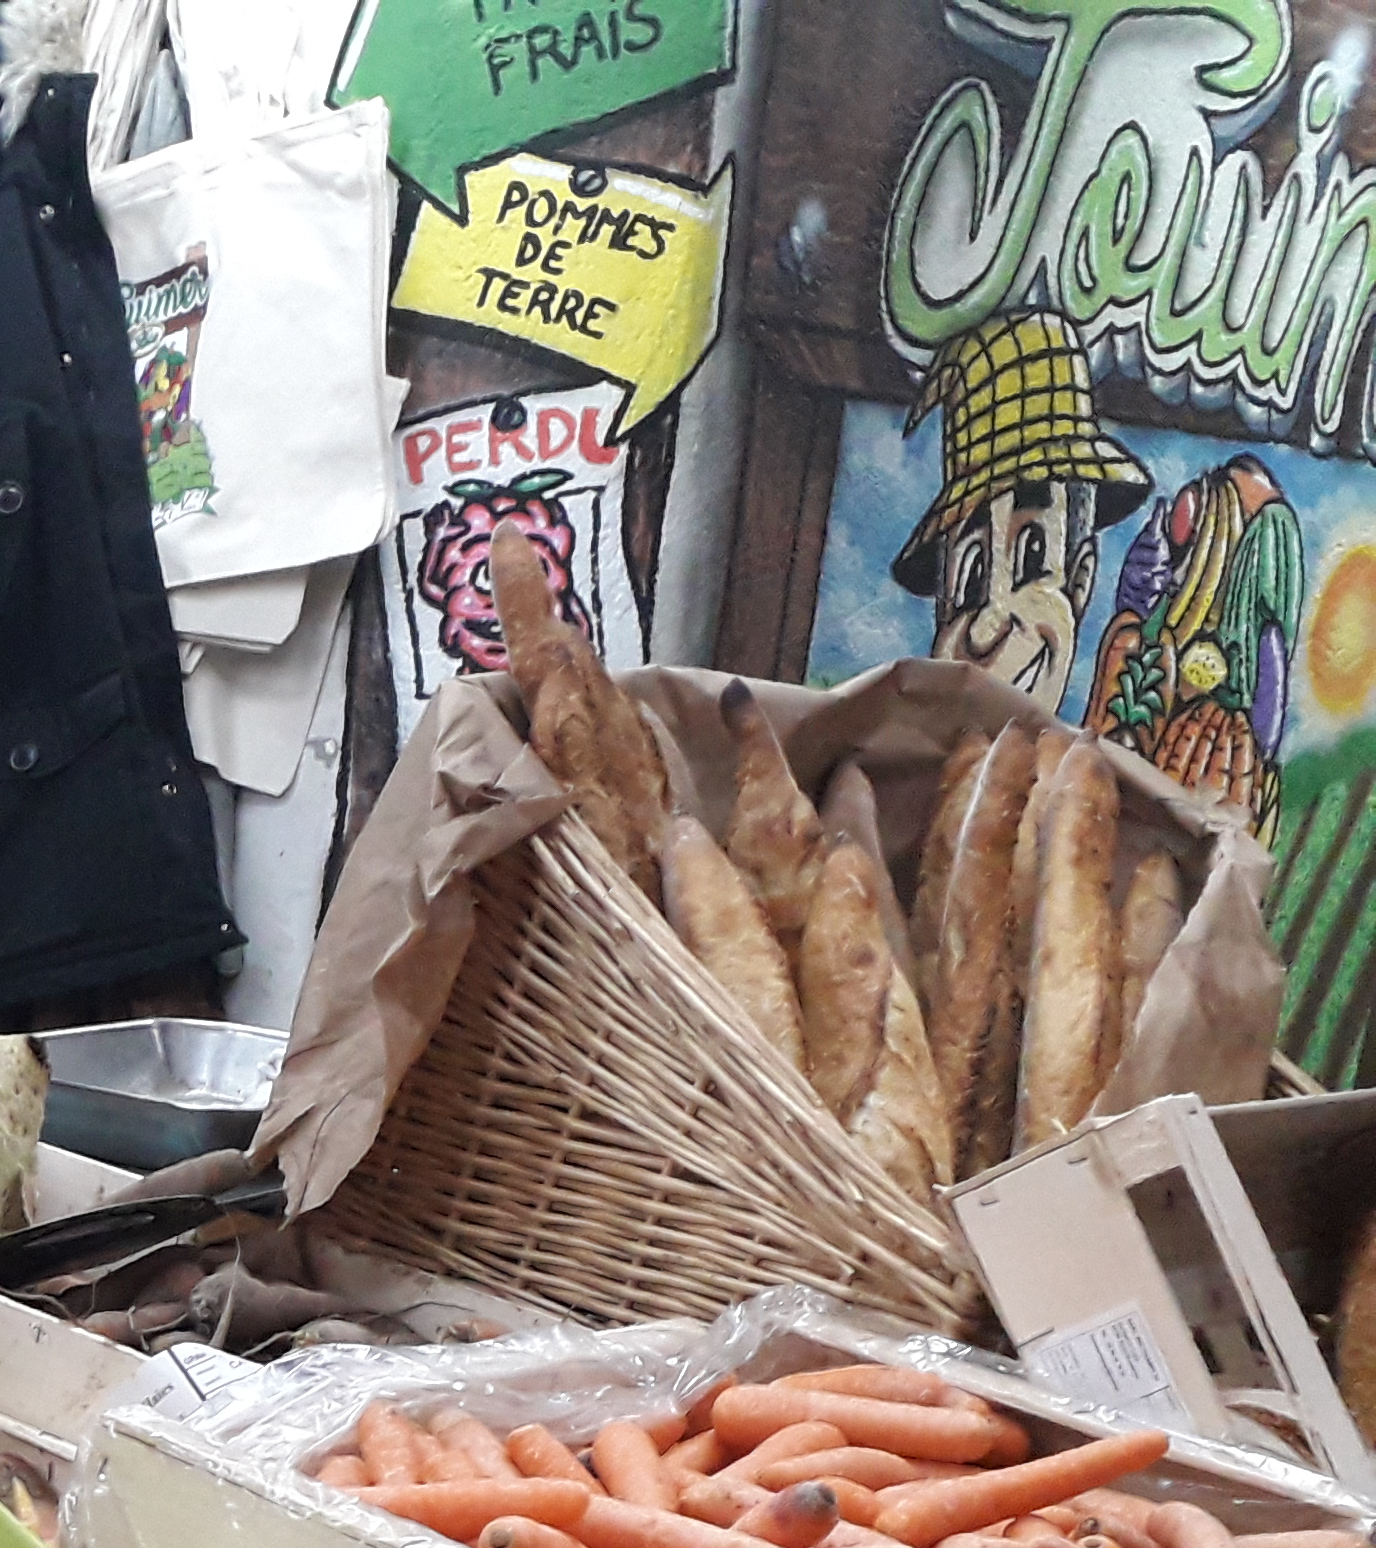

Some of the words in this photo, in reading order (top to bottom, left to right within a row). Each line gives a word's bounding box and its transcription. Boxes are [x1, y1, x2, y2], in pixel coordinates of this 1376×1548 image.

[483, 0, 665, 96] FRAIS
[495, 180, 677, 260] POMMES
[514, 230, 573, 275] DE
[474, 266, 620, 340] TERRE
[402, 406, 620, 485] PERDU
